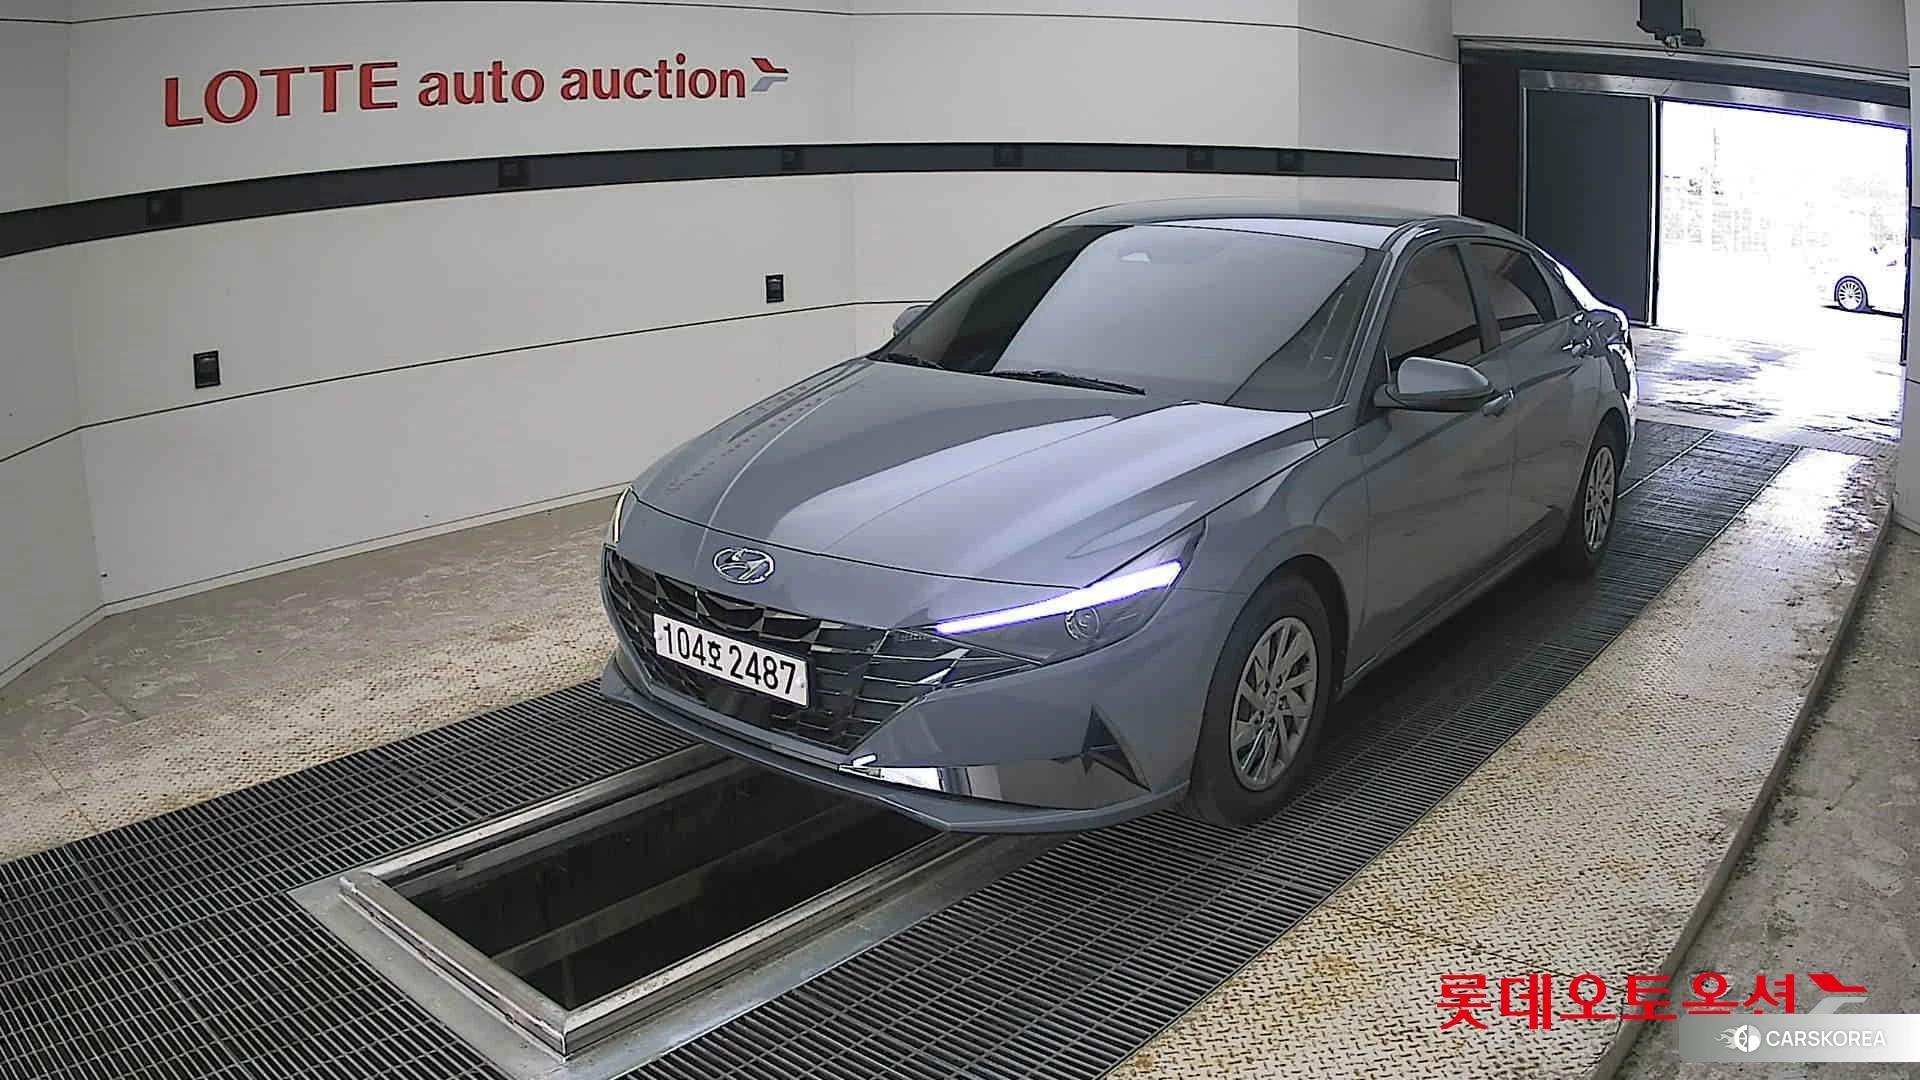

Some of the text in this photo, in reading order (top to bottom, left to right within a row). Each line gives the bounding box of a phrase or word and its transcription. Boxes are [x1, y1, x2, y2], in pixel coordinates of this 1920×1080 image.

[164, 53, 747, 128] LOTTE auto auction
[663, 622, 796, 694] 104호 2487
